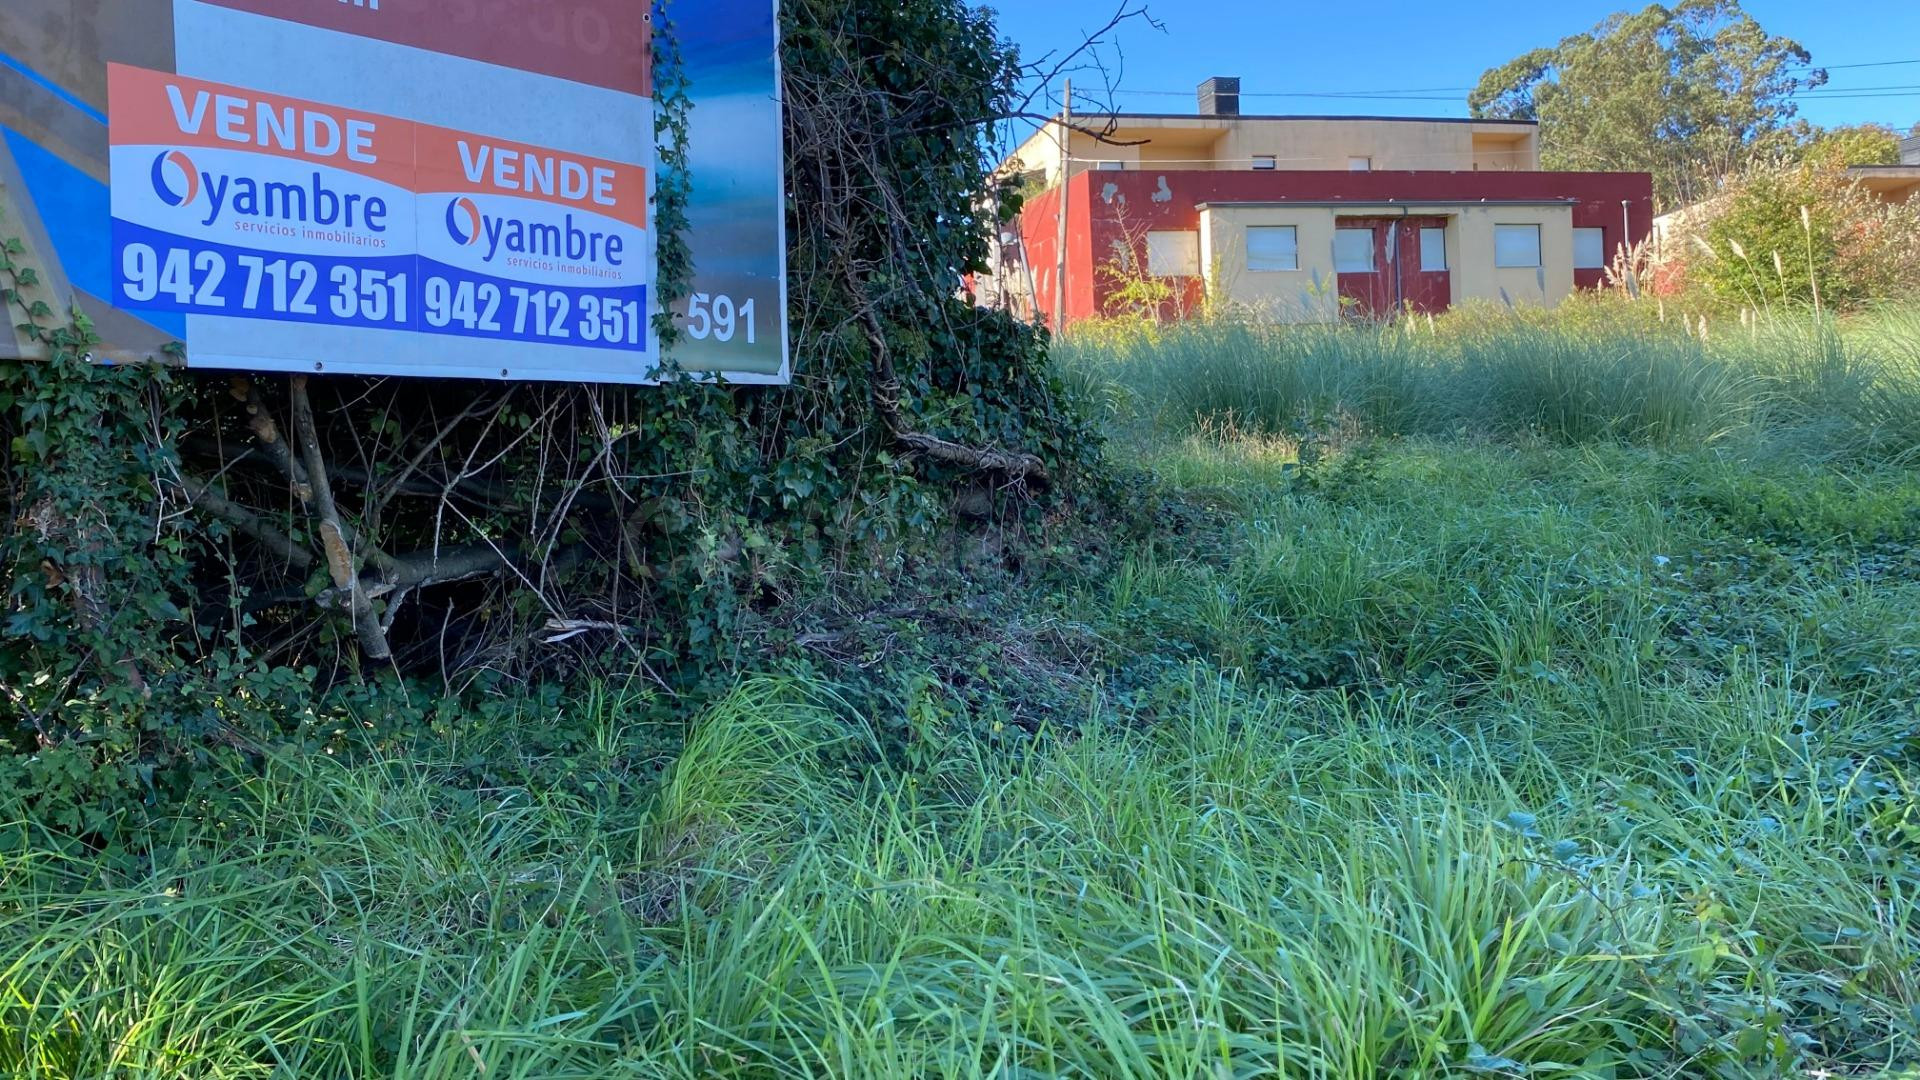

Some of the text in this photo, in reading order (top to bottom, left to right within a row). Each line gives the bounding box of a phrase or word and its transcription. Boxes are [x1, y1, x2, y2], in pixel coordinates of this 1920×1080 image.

[165, 84, 377, 164] VENDE
[151, 150, 387, 232] Oyambre
[457, 140, 617, 206] VENDE
[234, 221, 386, 248] servicios inmobiliarios
[446, 196, 623, 266] Oyambre
[122, 243, 407, 322] 942 712 351
[506, 256, 623, 280] servicios inmobiliarios
[425, 276, 639, 344] 942 712 351
[687, 293, 756, 344] 591
